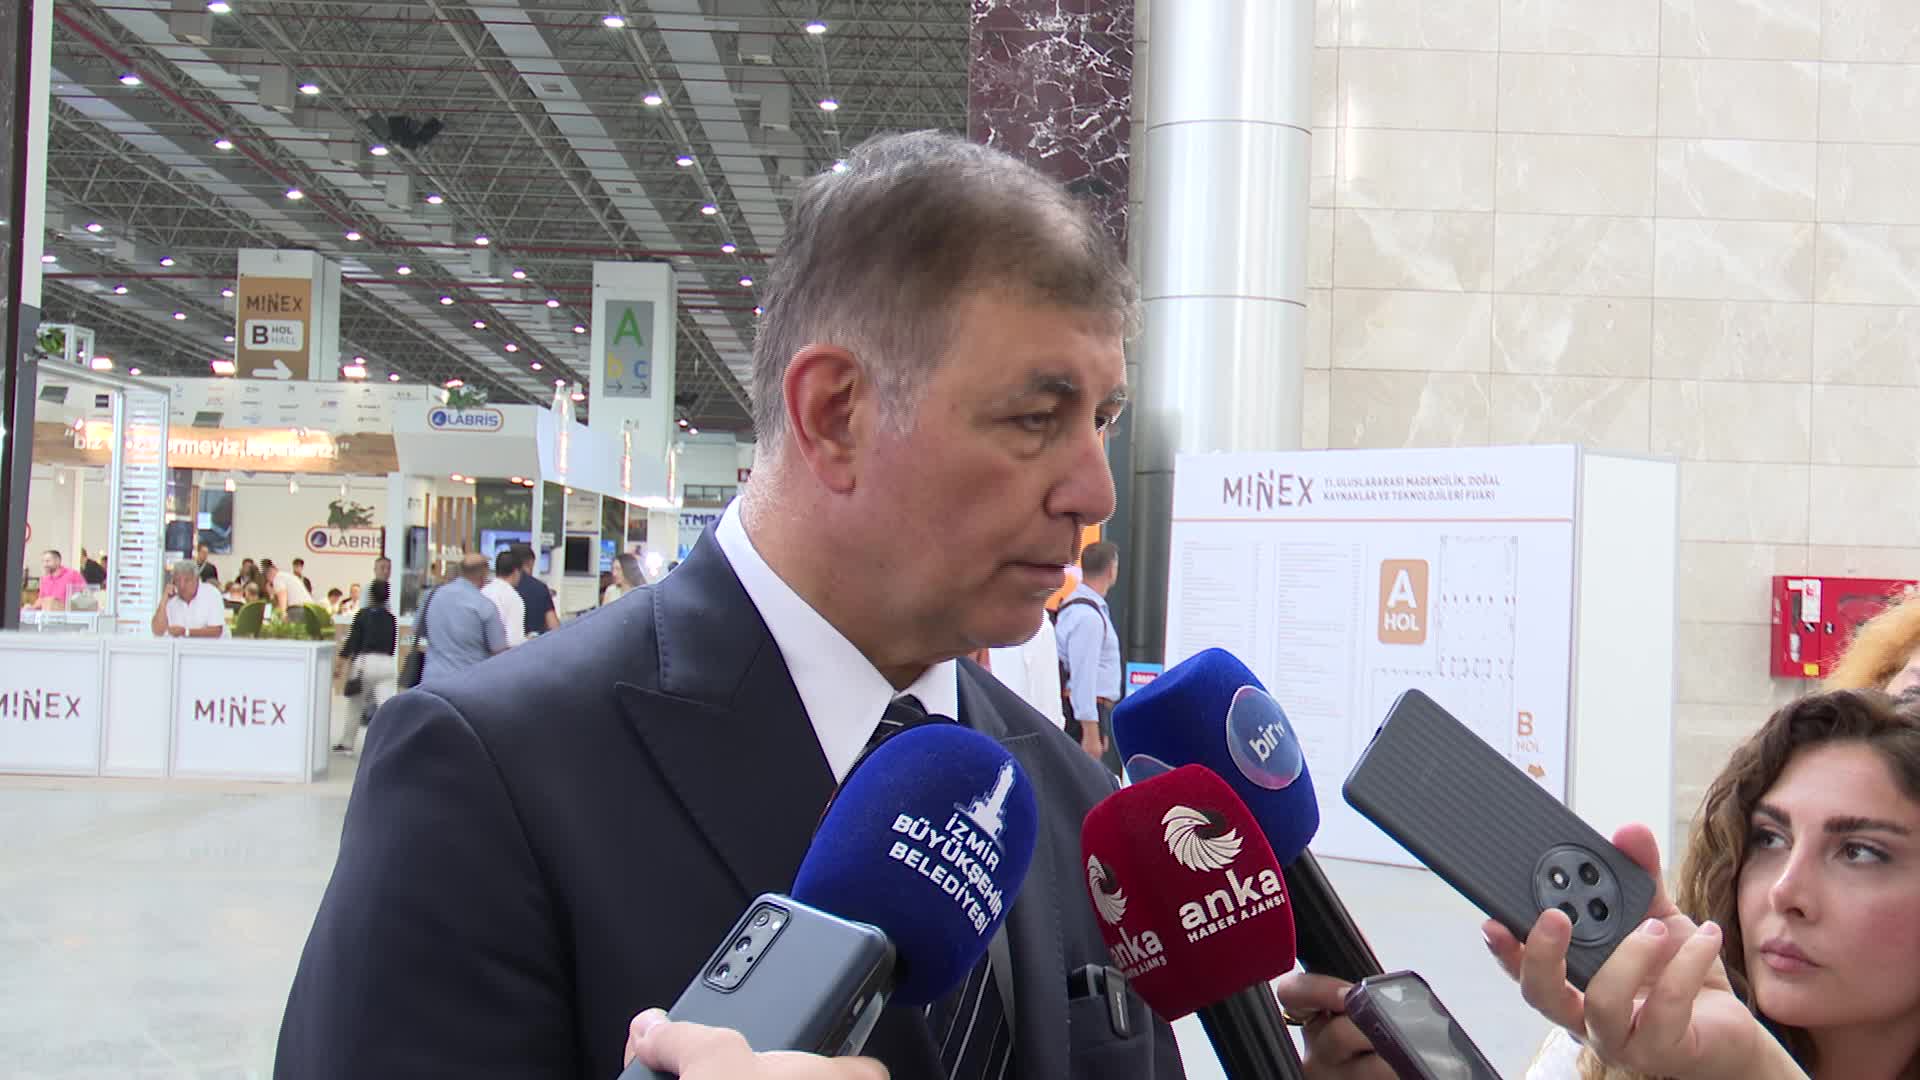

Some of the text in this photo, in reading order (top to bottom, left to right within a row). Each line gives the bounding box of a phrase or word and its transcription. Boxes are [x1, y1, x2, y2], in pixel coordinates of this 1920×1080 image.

[252, 325, 294, 345] B HOL
[613, 306, 643, 346] A
[272, 336, 297, 345] HALL
[607, 351, 625, 378] b
[1323, 490, 1377, 502] KAYNAKLAR
[1387, 569, 1418, 608] A
[1384, 611, 1420, 631] HOL
[1517, 711, 1534, 736] B
[1516, 740, 1541, 753] HOL
[945, 812, 1001, 873] İZMİR
[891, 814, 1004, 921] BÜYÜKŞEHİR
[888, 841, 992, 937] BELEDİYESİ
[1178, 868, 1282, 931] anka
[1186, 914, 1237, 944] HABER
